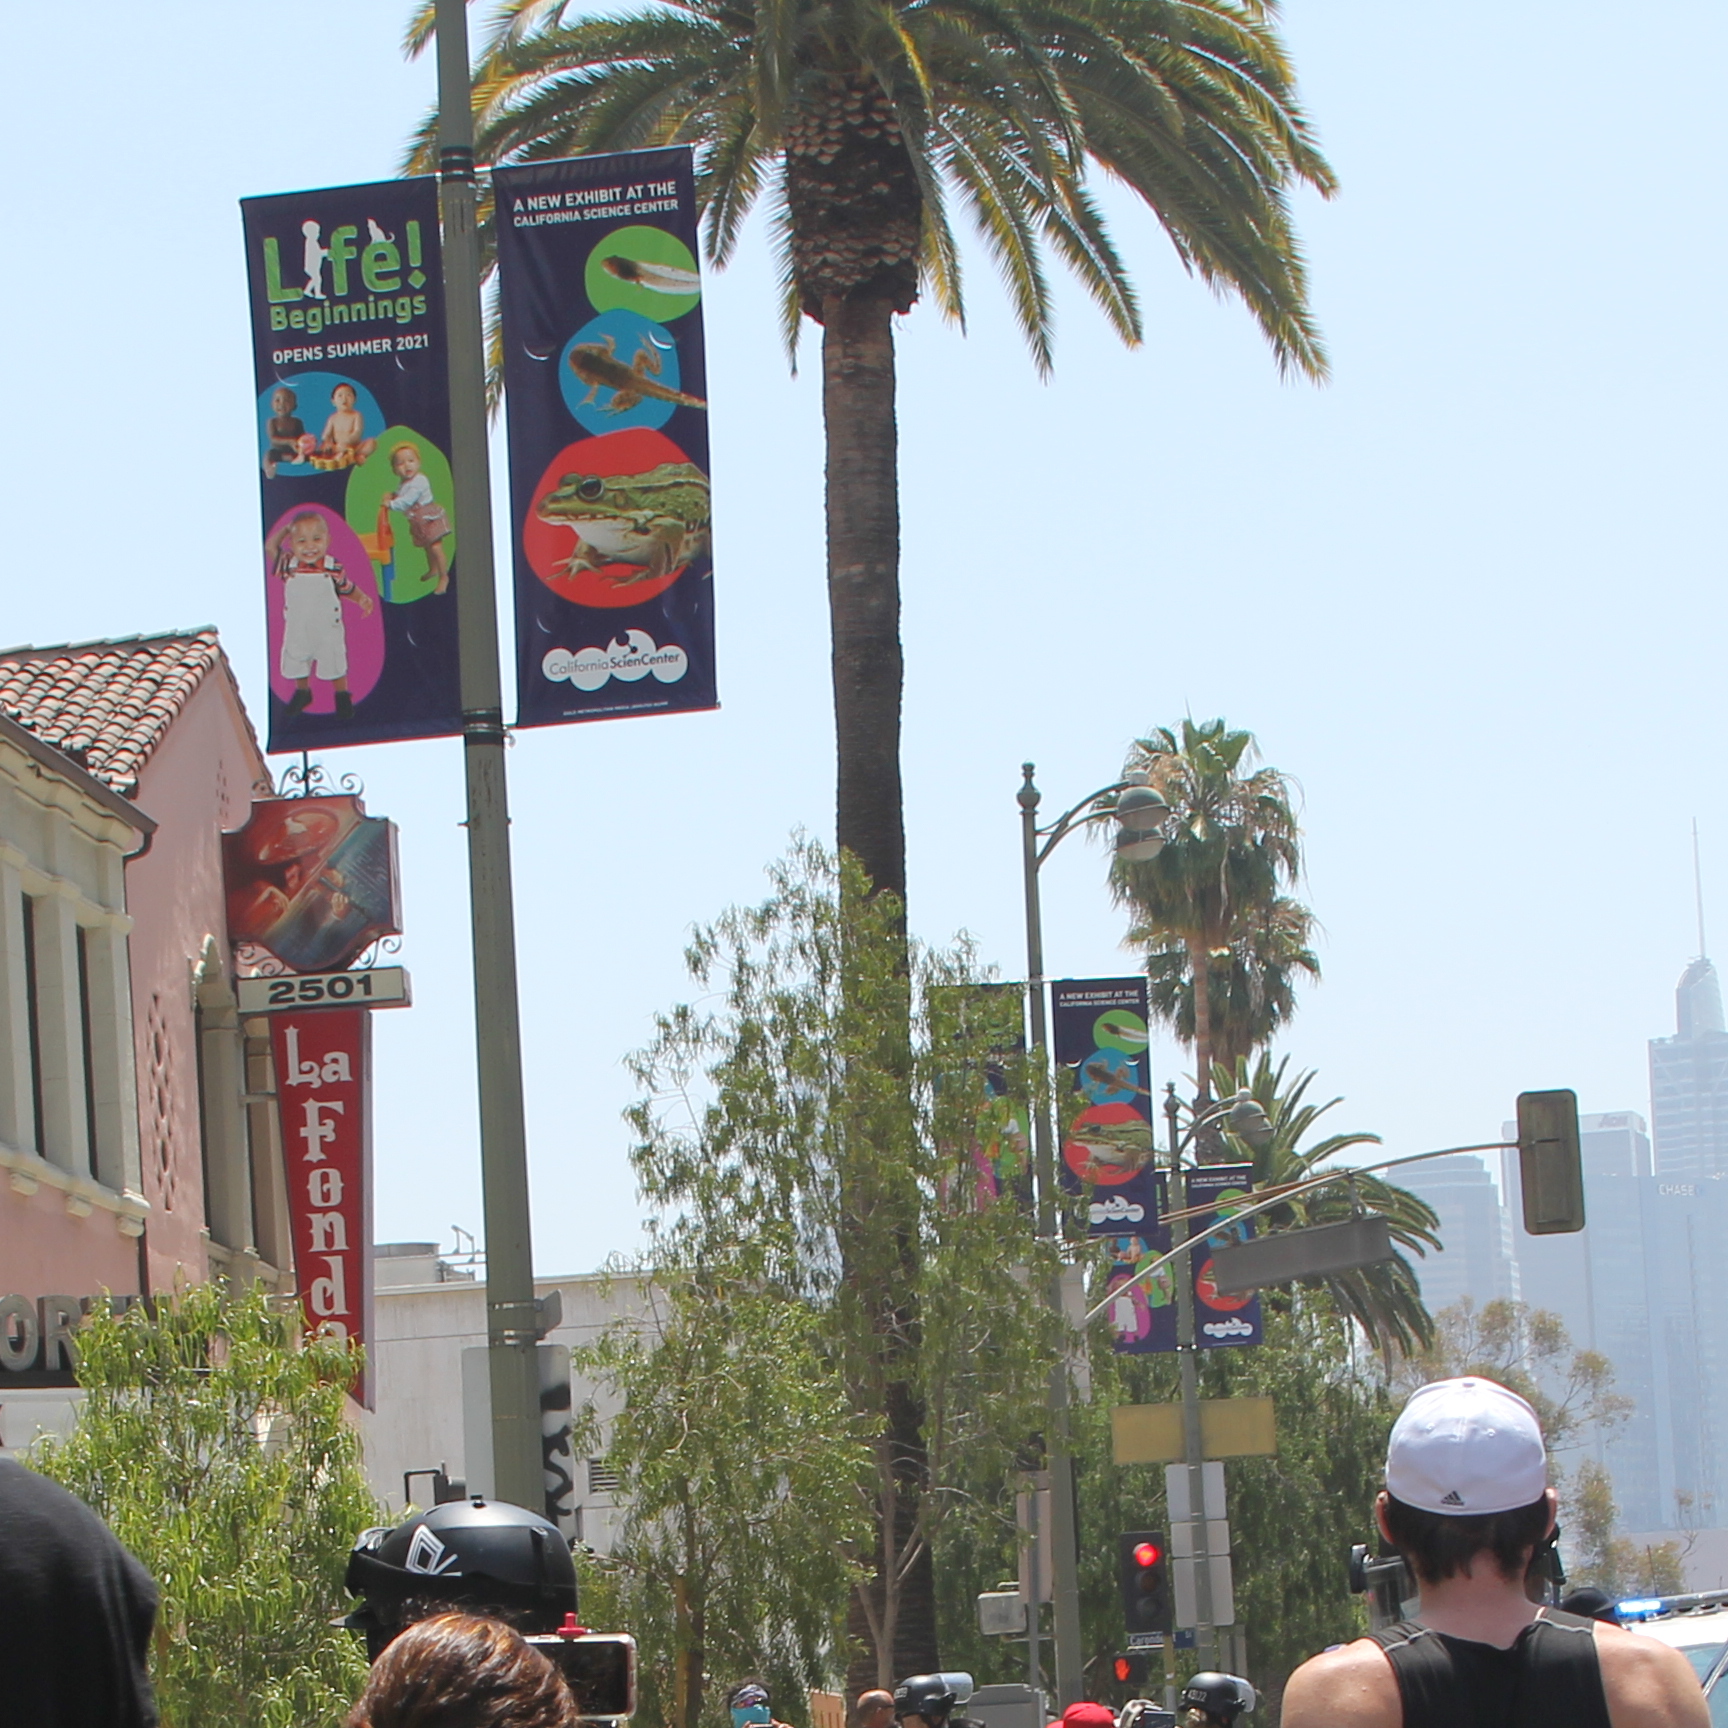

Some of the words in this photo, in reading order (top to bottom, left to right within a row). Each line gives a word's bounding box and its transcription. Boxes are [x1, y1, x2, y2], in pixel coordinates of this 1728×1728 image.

[513, 198, 525, 212] A
[527, 194, 561, 211] NEW
[565, 187, 622, 207] EXHIBIT
[626, 185, 643, 200] AT
[647, 181, 676, 197] THE
[513, 211, 582, 227] CALIFORNIA
[583, 205, 631, 221] SCIENCE
[634, 199, 679, 215] CENTER
[270, 295, 427, 333] Beginnings
[273, 346, 323, 364] OPENS
[327, 339, 392, 358] SUMMER
[396, 334, 429, 351] 2021
[269, 974, 373, 1004] 2501
[284, 1025, 353, 1088] La
[1659, 1183, 1695, 1196] CHASE
